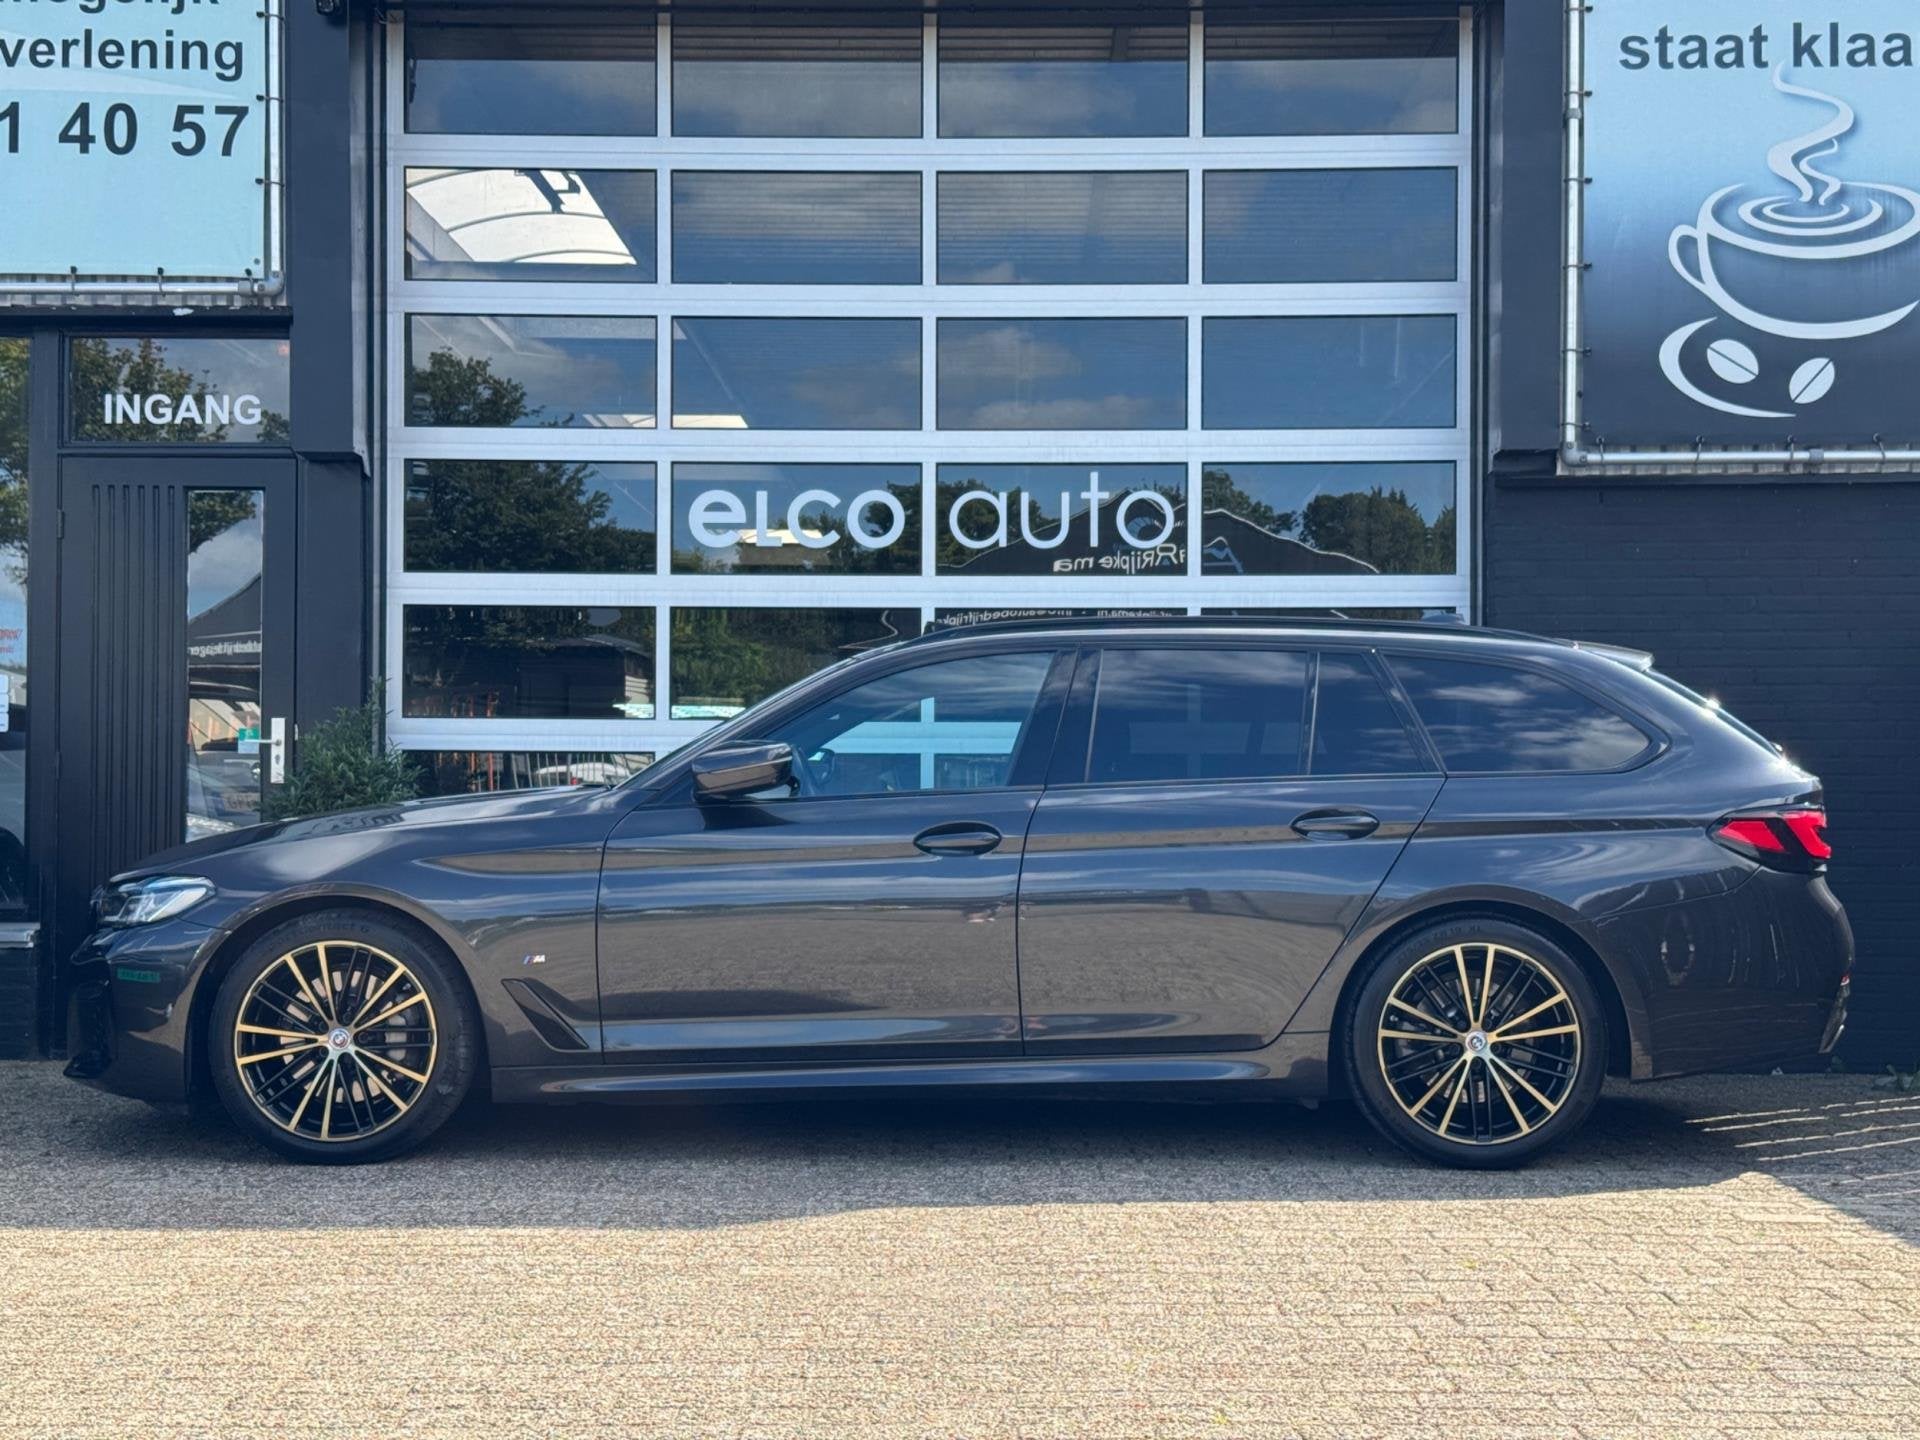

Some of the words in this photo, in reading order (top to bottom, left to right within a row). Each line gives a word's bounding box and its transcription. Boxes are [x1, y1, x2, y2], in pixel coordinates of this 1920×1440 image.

[0, 28, 243, 82] verlening
[1619, 24, 1769, 70] staat
[1792, 22, 1913, 68] klaa
[0, 101, 20, 154] 1
[58, 102, 138, 155] 40
[171, 104, 250, 157] 57
[104, 393, 262, 425] INGANG
[948, 471, 1175, 549] auto
